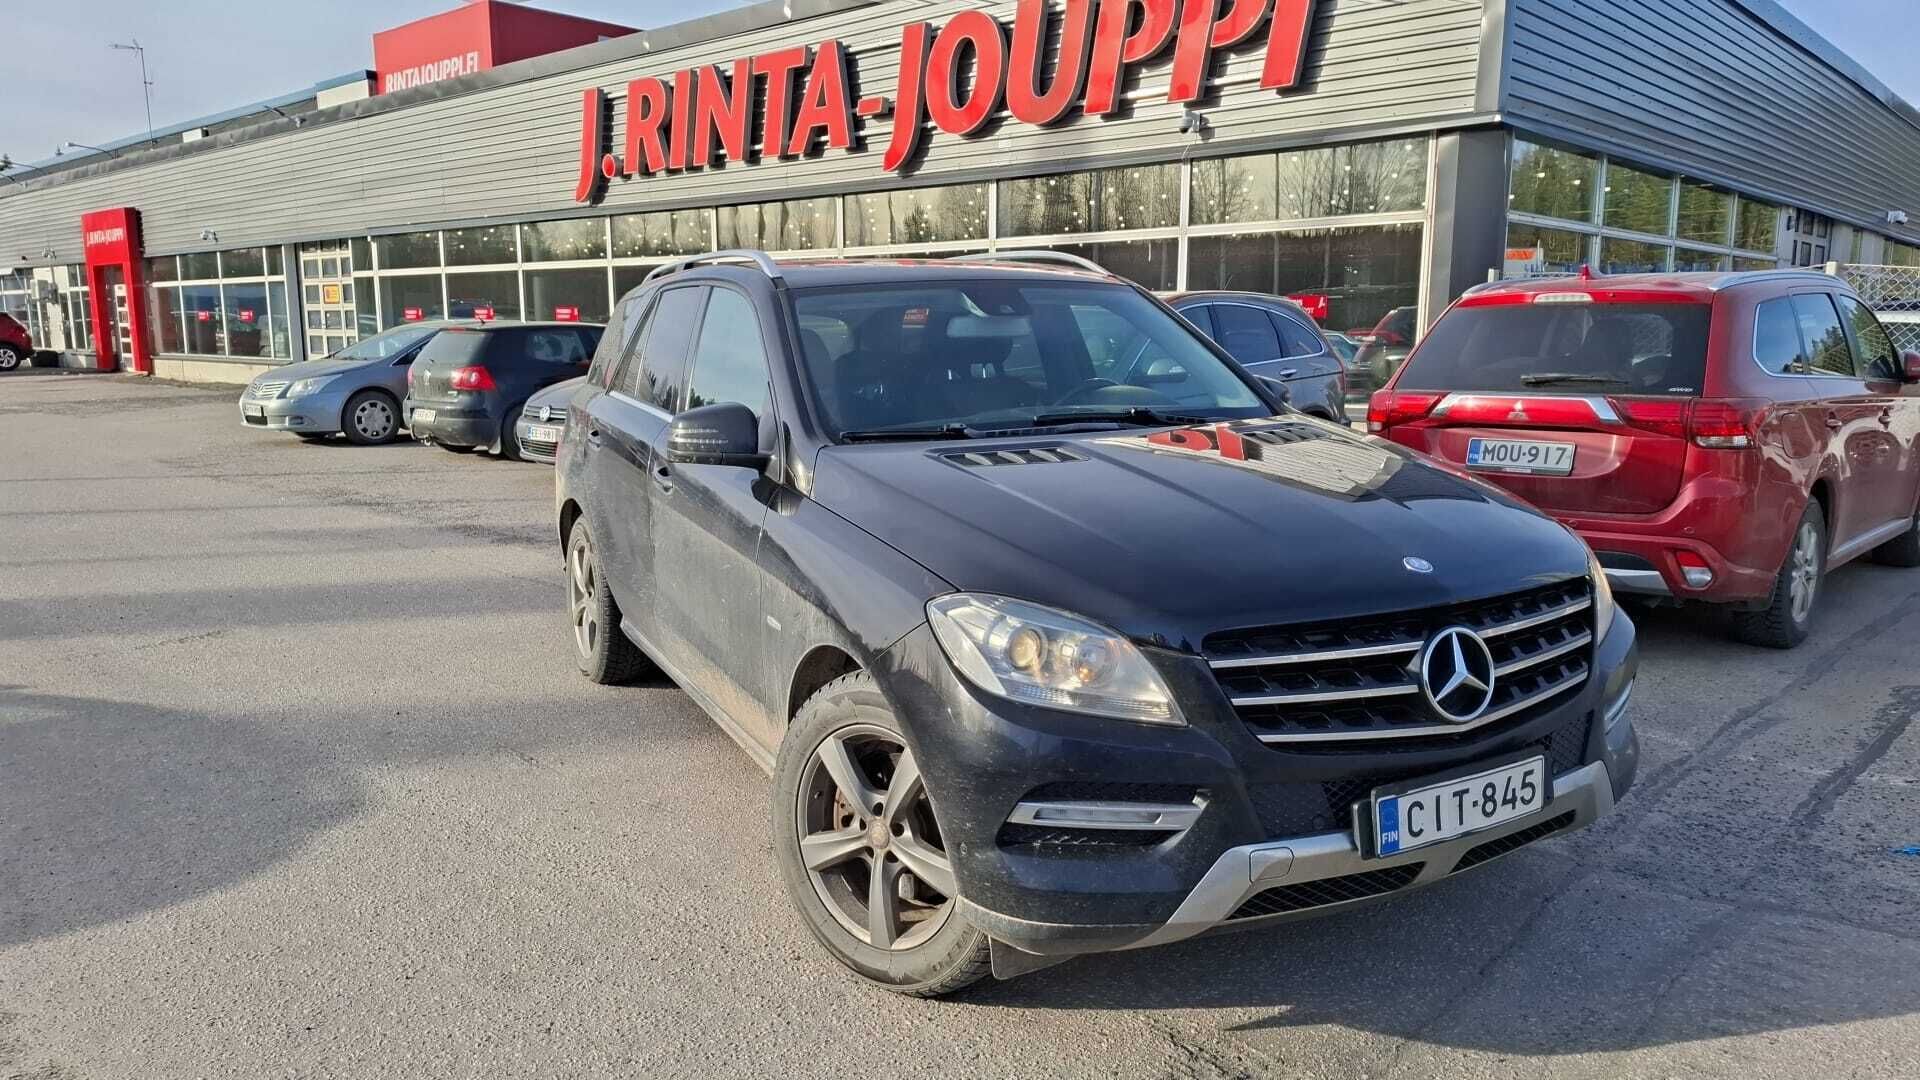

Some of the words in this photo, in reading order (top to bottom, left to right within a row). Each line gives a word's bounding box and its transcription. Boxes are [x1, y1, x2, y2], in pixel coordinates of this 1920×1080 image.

[575, 0, 1312, 203] J.RINTA-JOUPPI
[1482, 443, 1568, 465] MOU-917
[1407, 769, 1537, 838] CIT-845
[1382, 830, 1398, 845] FIN
